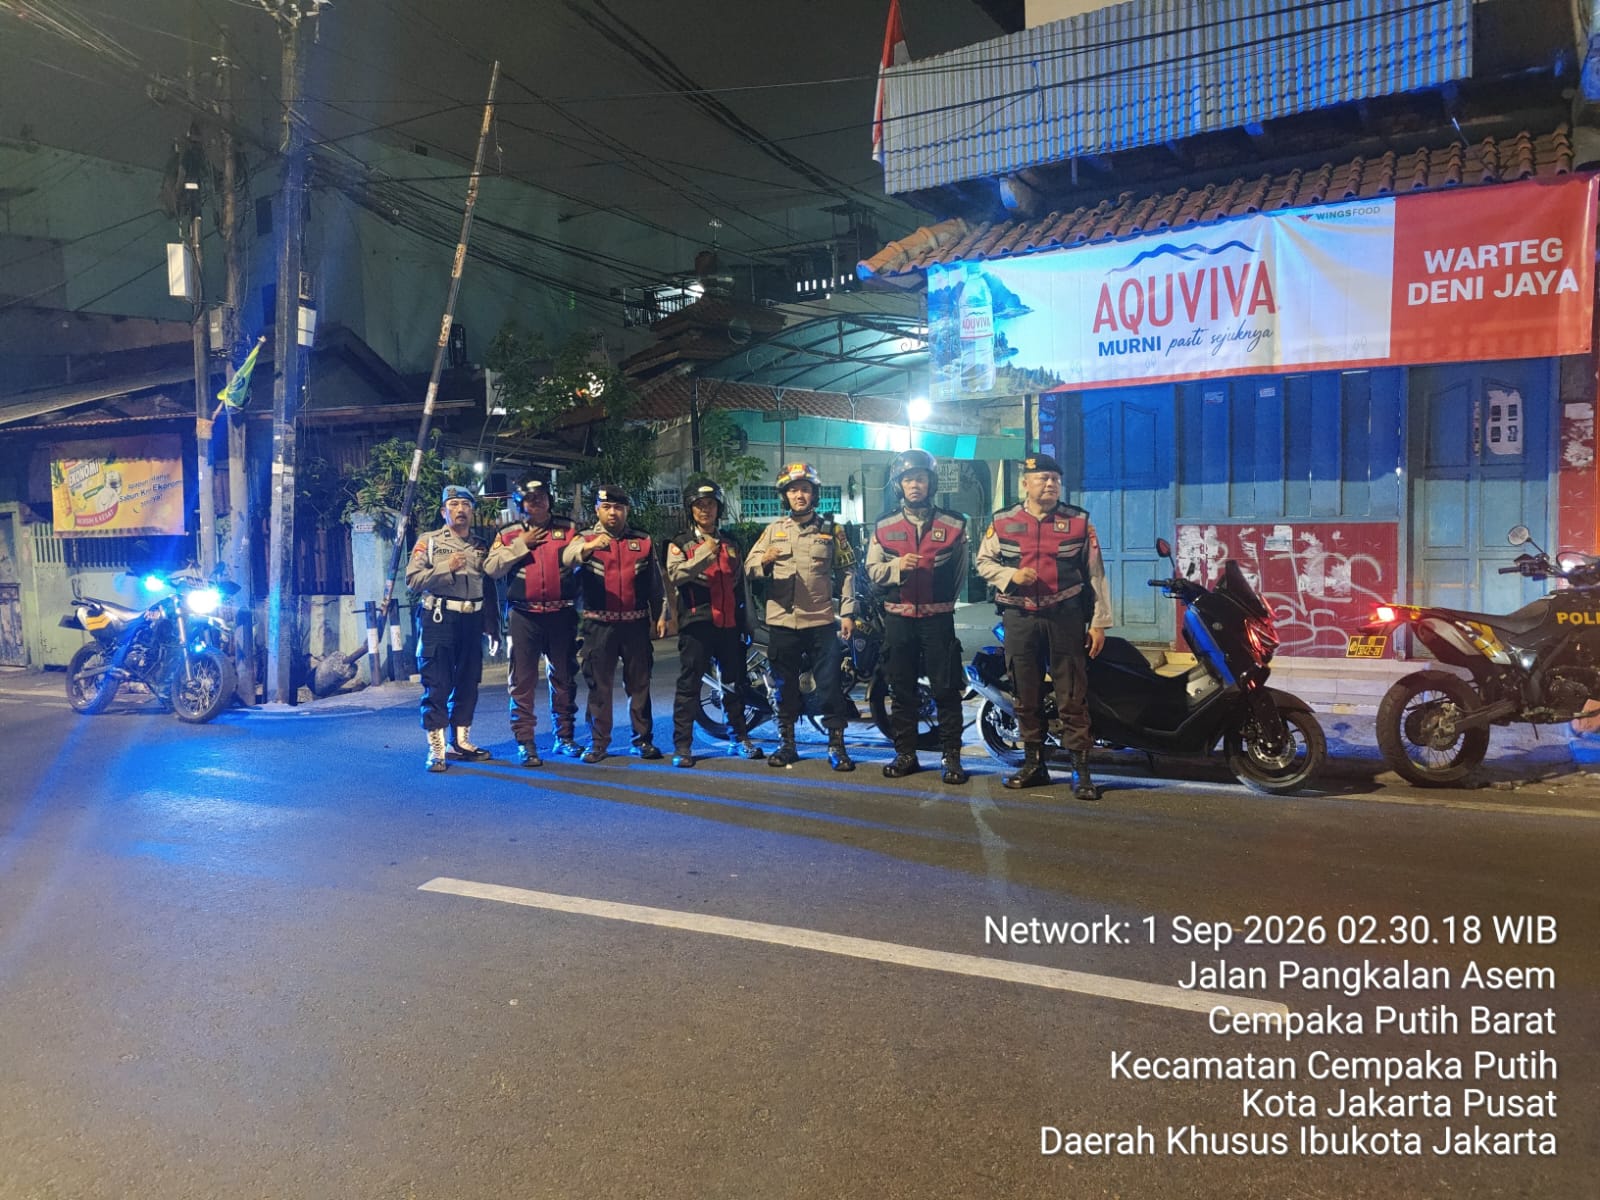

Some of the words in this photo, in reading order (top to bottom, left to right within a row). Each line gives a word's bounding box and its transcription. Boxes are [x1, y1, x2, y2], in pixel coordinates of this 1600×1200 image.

[1315, 206, 1381, 220] WINGSFOOD
[1424, 237, 1564, 274] WARTEG
[1092, 260, 1277, 335] AQUVIVA
[1407, 276, 1484, 306] DENI
[1493, 268, 1579, 298] JAYA
[1098, 335, 1162, 357] MURNI
[1165, 326, 1209, 357] pasti
[1210, 319, 1274, 357] sejuknya
